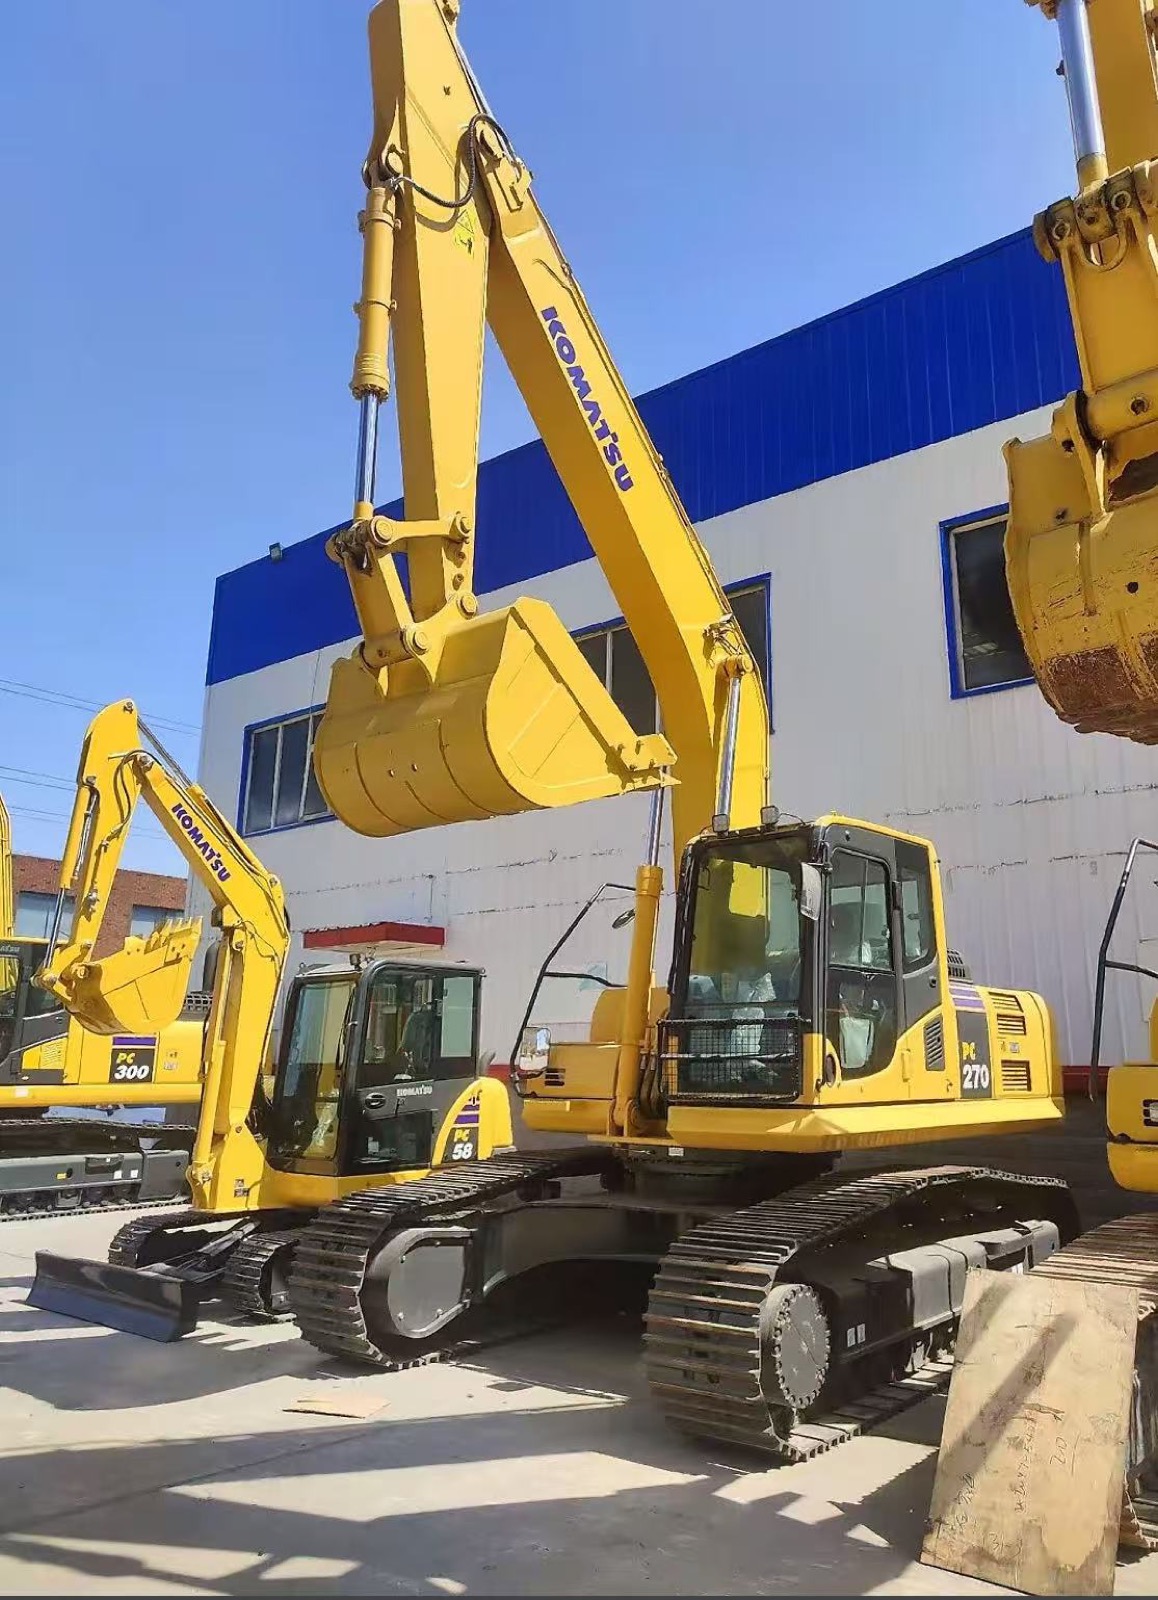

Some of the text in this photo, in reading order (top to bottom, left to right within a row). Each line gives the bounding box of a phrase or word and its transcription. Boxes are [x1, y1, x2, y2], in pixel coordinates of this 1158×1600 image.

[540, 306, 634, 492] KOMATSU
[171, 803, 231, 882] KOMATSU
[116, 1052, 135, 1065] PC
[961, 1042, 976, 1060] PC
[114, 1065, 150, 1080] 300
[962, 1064, 990, 1089] 270
[453, 1129, 470, 1142] PC
[452, 1143, 474, 1160] 58
